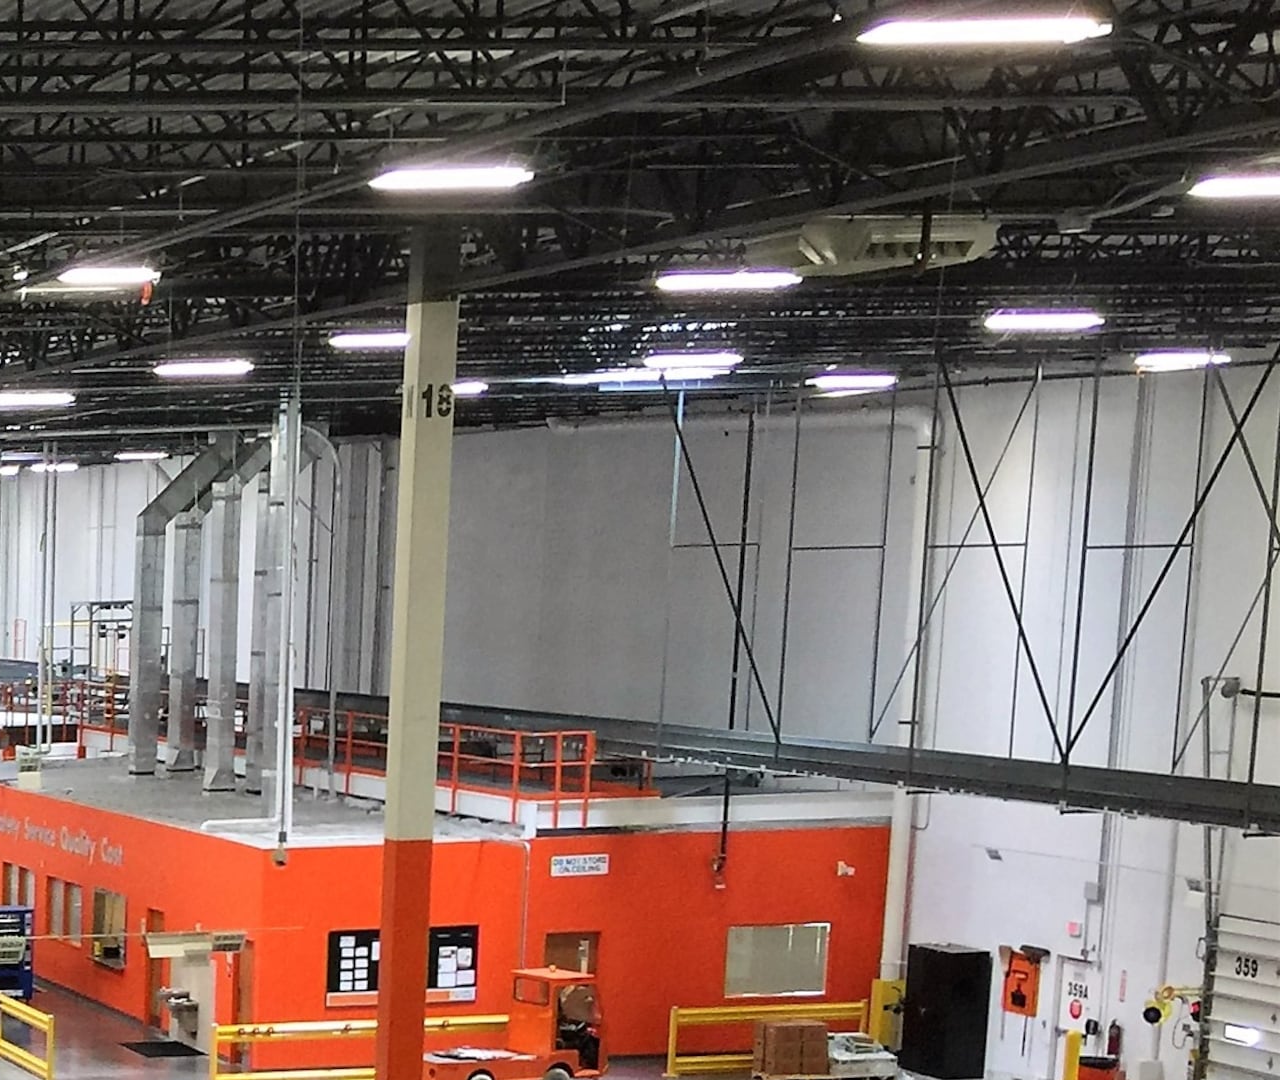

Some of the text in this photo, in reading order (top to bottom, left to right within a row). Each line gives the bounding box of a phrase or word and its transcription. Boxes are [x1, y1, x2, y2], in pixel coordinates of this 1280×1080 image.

[421, 383, 452, 418] 18
[1235, 956, 1258, 978] 359
[1068, 981, 1089, 999] 359A
